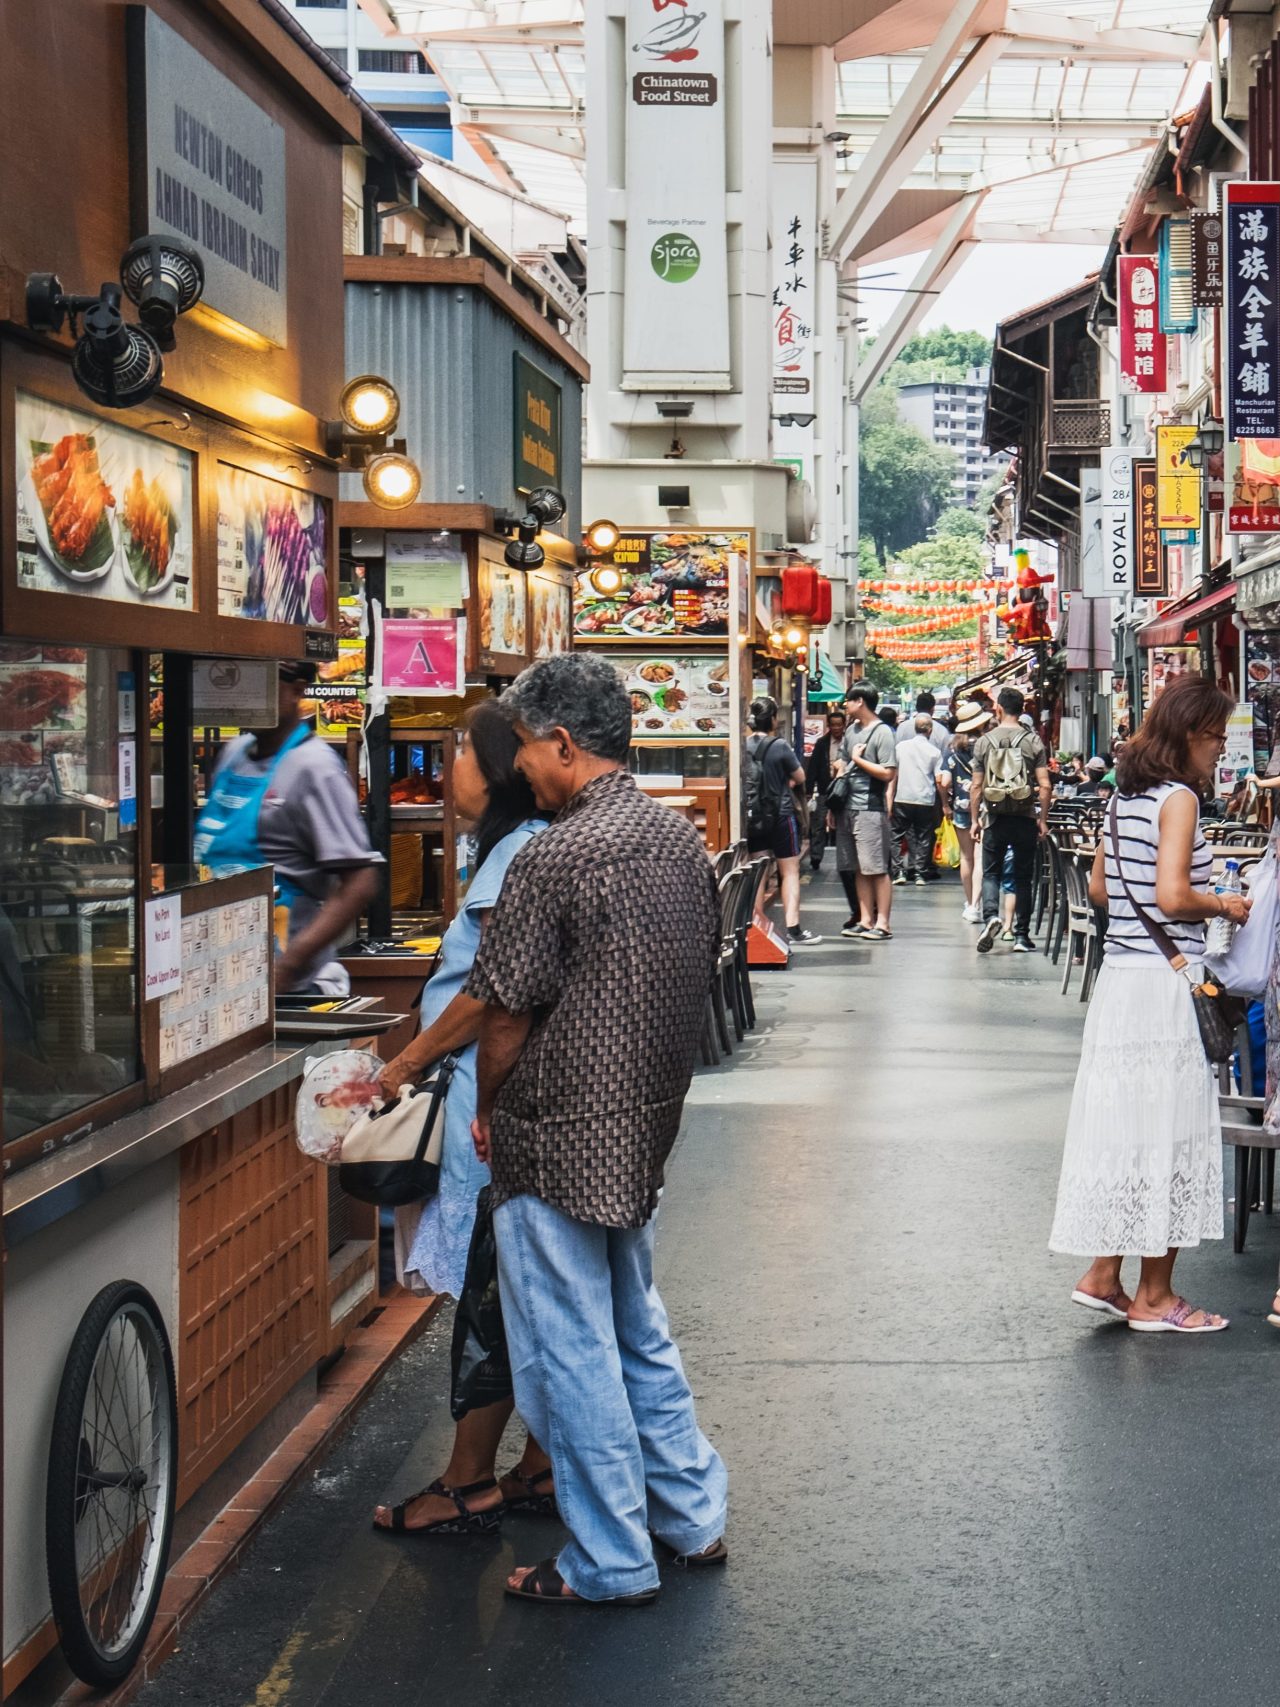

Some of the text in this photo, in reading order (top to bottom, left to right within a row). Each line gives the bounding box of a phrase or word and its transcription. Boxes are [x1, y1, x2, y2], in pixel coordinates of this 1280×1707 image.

[641, 76, 709, 88] Chinatown
[641, 91, 710, 102] Food Street
[174, 103, 263, 215] NEWTON CIRCUS
[647, 218, 706, 227] Beverage Partner
[156, 167, 280, 292] AHMAD IBRAHIM SATAY
[654, 240, 699, 277] sjora
[1246, 416, 1265, 425] TEL:
[1236, 426, 1275, 434] 6225 8663
[1112, 512, 1127, 584] ROYAL
[401, 640, 438, 674] A
[315, 687, 357, 696] COUNTER
